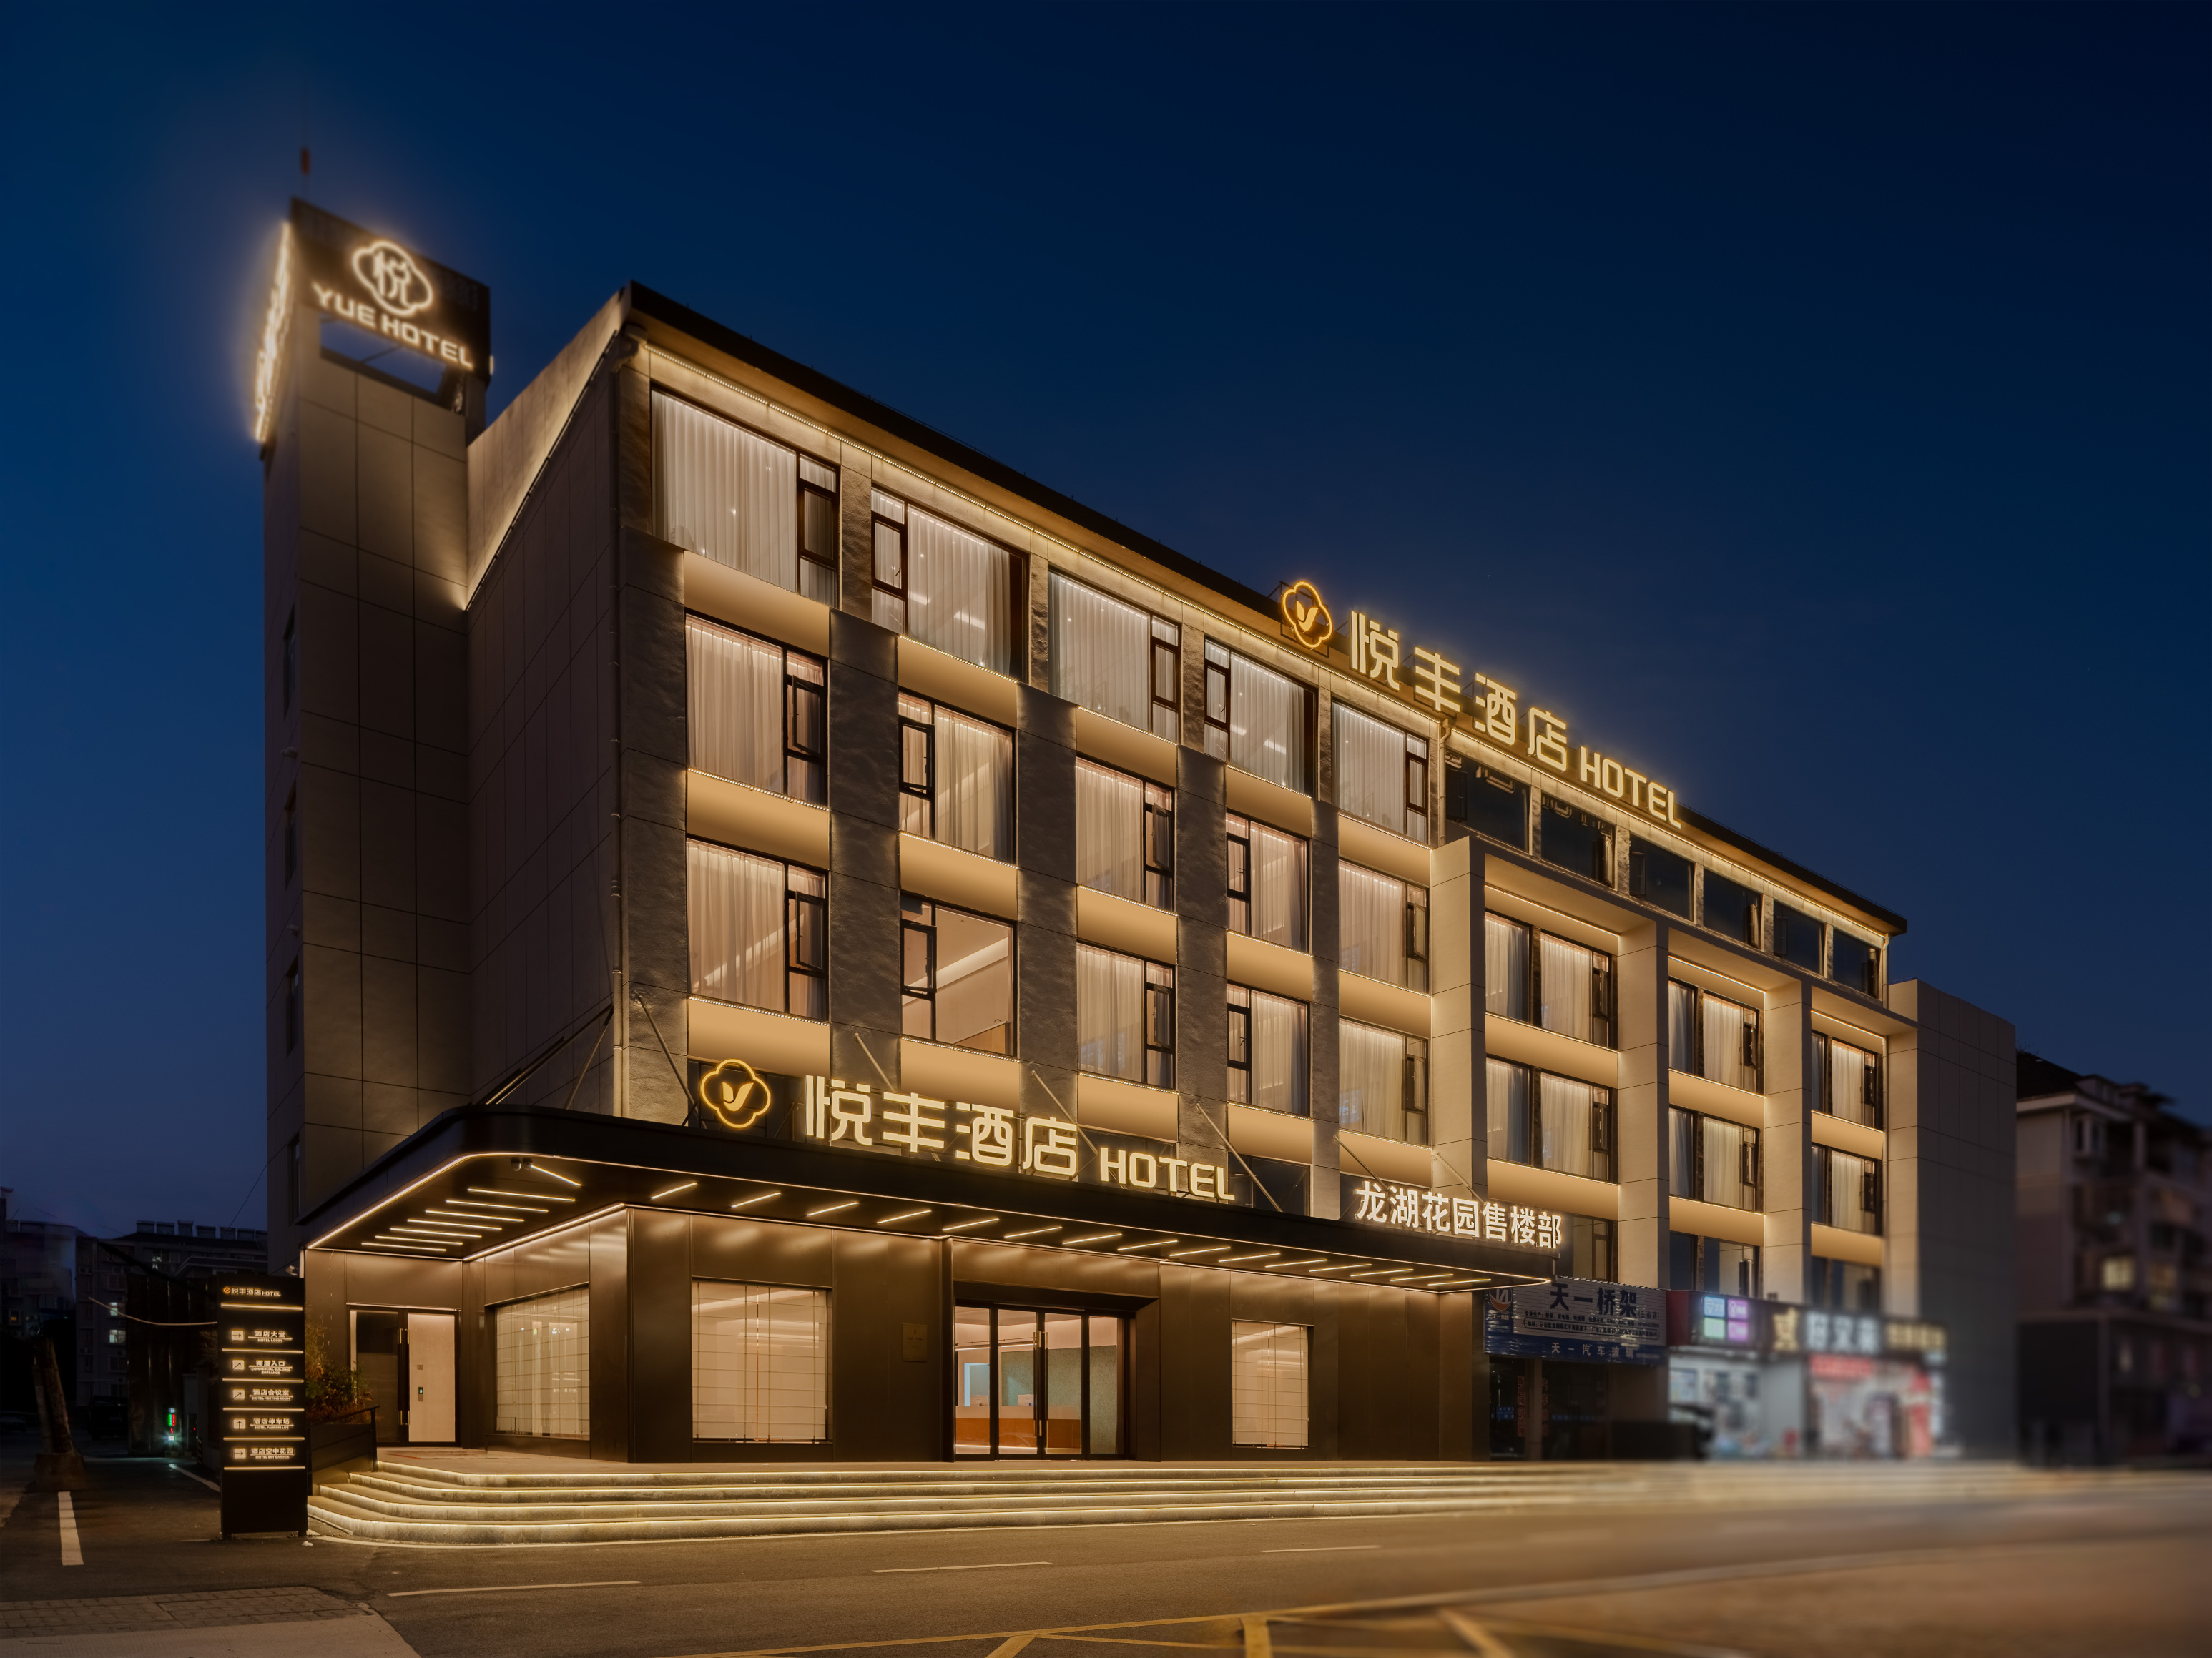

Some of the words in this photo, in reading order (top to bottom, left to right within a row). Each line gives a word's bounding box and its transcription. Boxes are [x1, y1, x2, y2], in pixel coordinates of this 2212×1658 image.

[312, 282, 377, 328] YUE
[380, 314, 473, 370] HOTEL
[1350, 611, 1568, 773] 悦丰酒店
[1579, 746, 1683, 829] HOTEL
[805, 1074, 1078, 1176] 悦丰酒店
[1100, 1146, 1235, 1200] HOTEL
[1355, 1180, 1563, 1249] 龙湖花园售楼部
[1549, 1283, 1638, 1317] 天一桥架
[1551, 1341, 1635, 1358] 天一汽车玻璃
